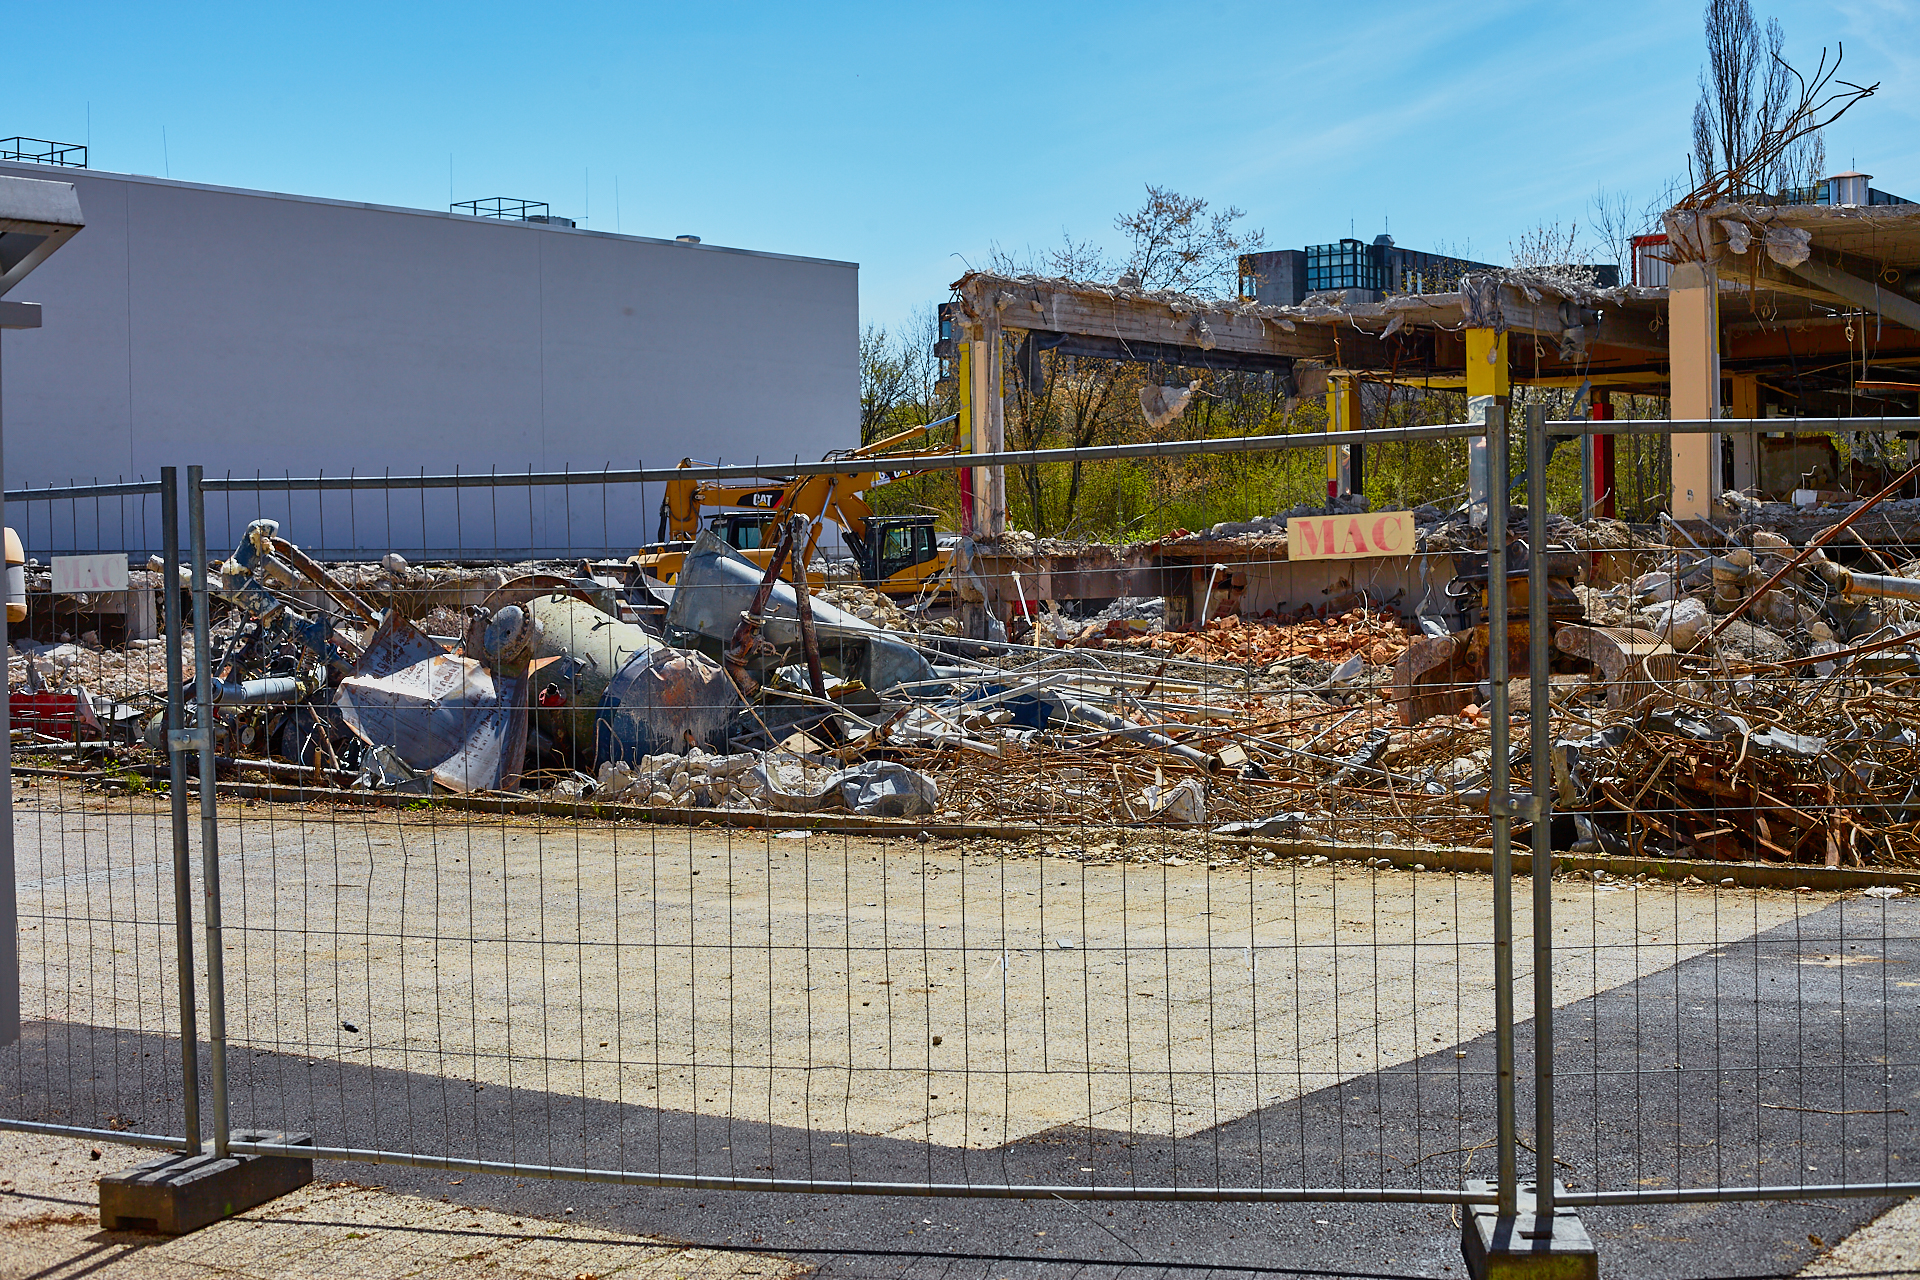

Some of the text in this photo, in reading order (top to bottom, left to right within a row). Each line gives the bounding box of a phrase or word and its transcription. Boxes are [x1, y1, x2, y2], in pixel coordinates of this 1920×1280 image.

[752, 493, 773, 507] CAT
[1294, 516, 1403, 556] MAC
[56, 557, 121, 589] MAC
